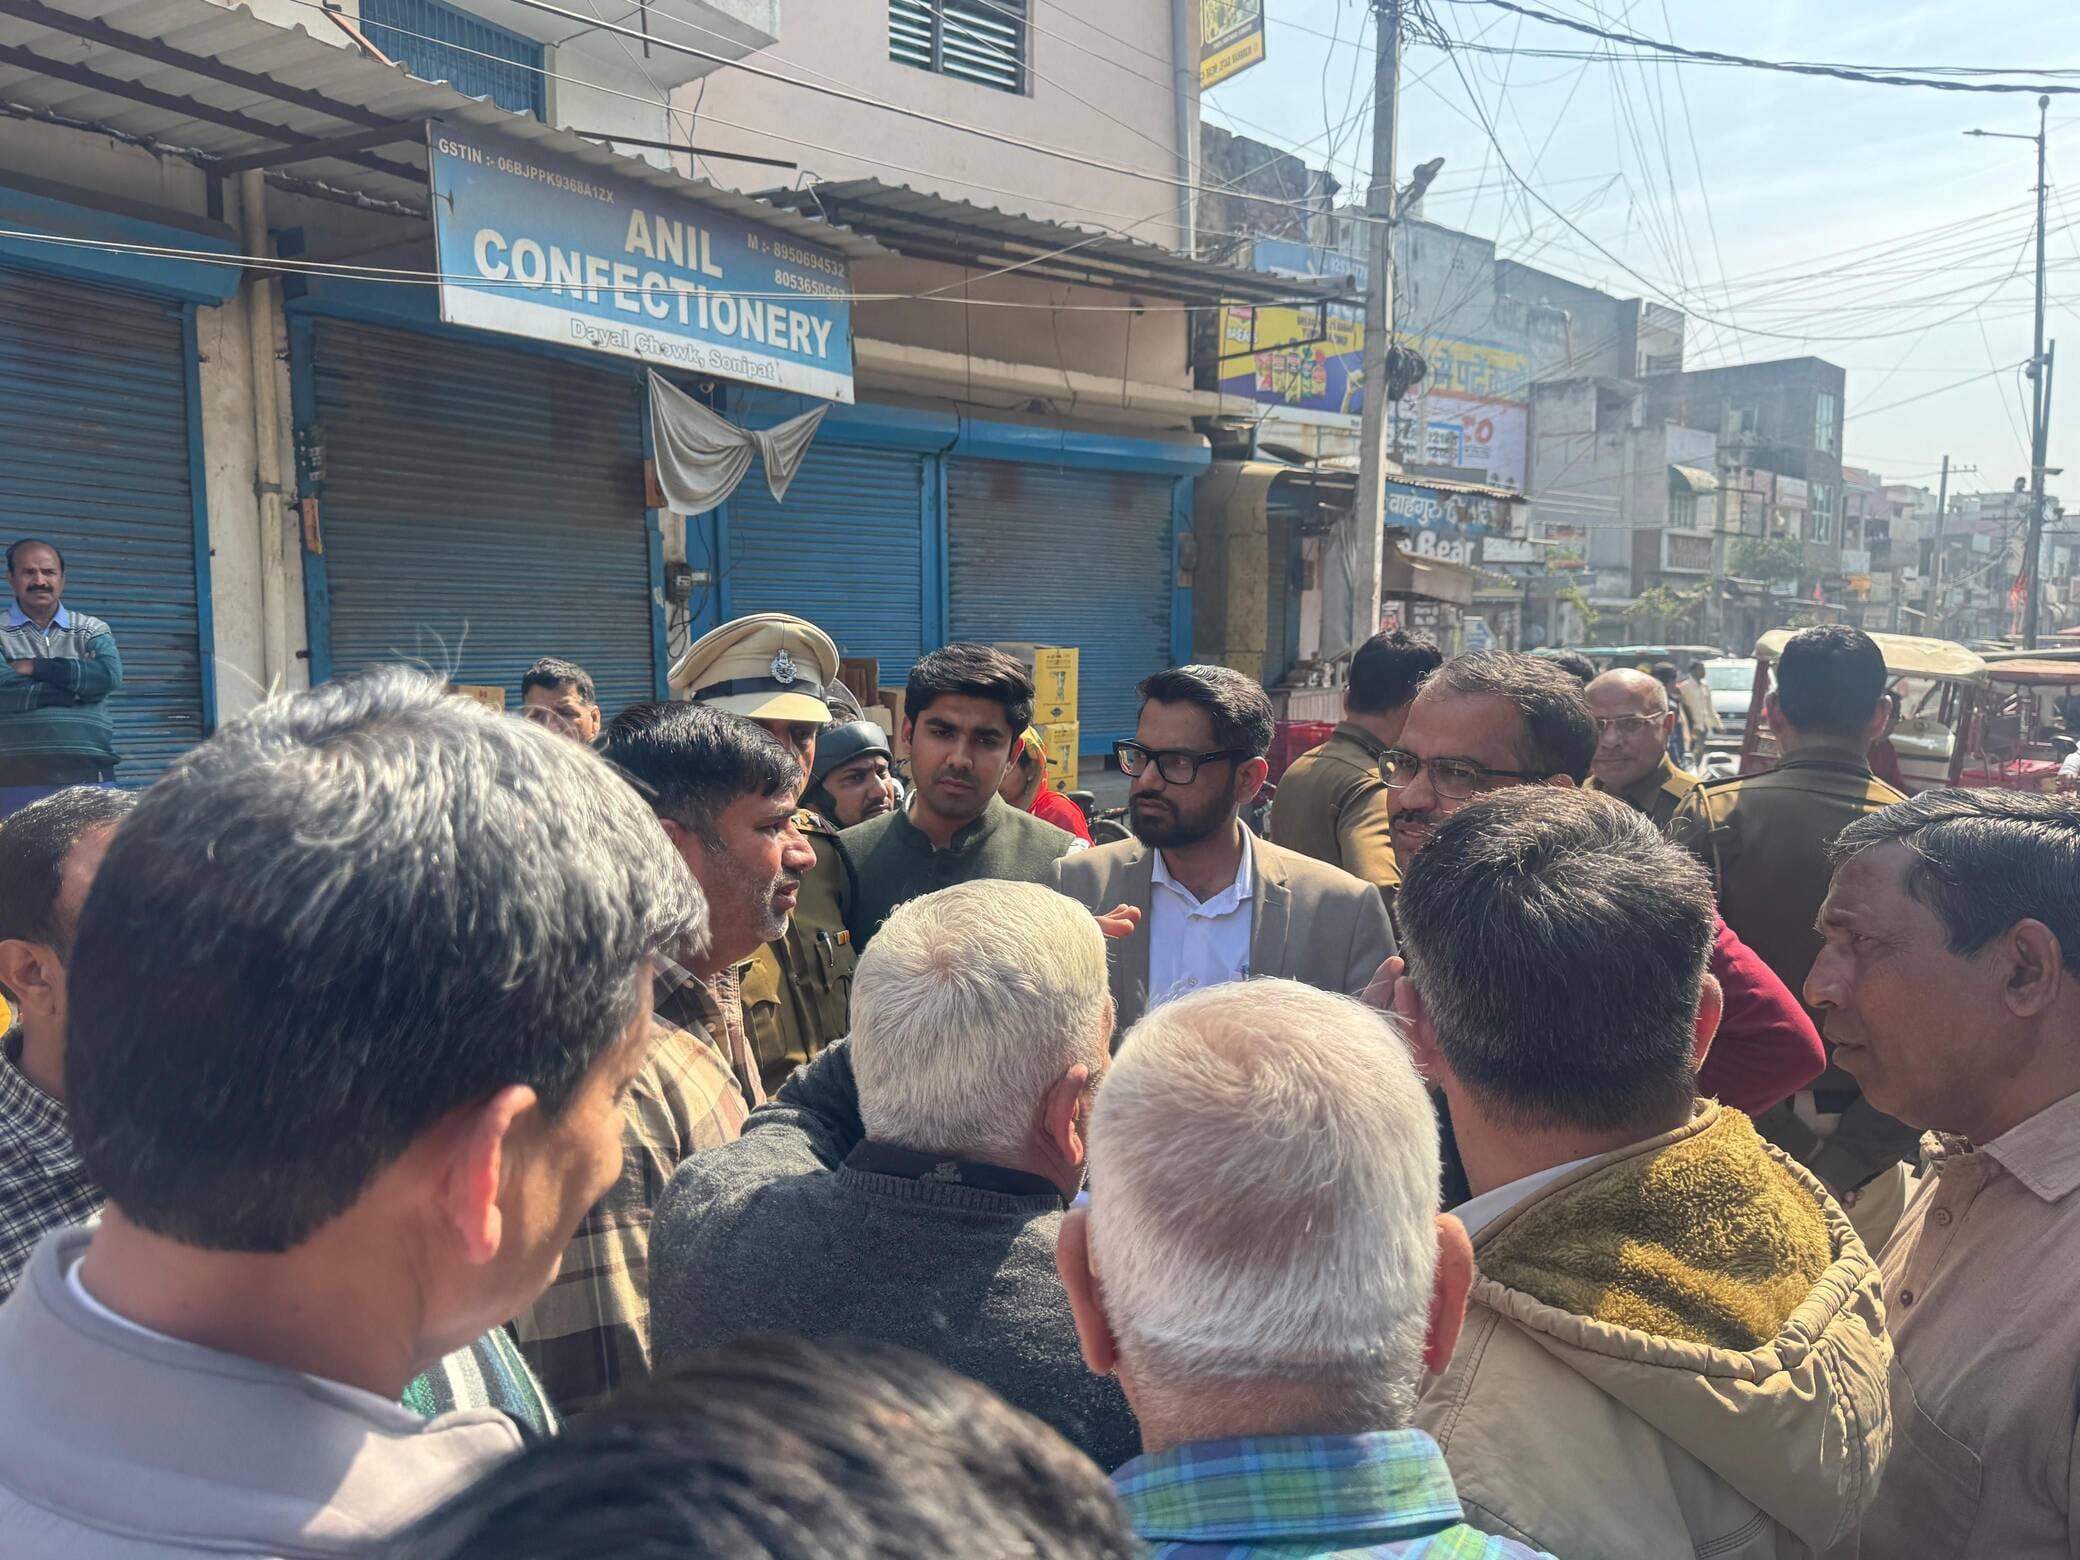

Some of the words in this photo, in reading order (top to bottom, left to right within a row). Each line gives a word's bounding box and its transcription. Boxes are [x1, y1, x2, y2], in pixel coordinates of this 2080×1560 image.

[438, 138, 482, 164] GSTIN
[624, 208, 724, 279] ANIL
[747, 233, 759, 250] M
[774, 242, 846, 278] 8950694532
[473, 228, 832, 360] CONFECTIONERY
[571, 318, 630, 348] Dayal
[634, 333, 705, 368] Chowk,
[709, 349, 776, 380] Sonipat
